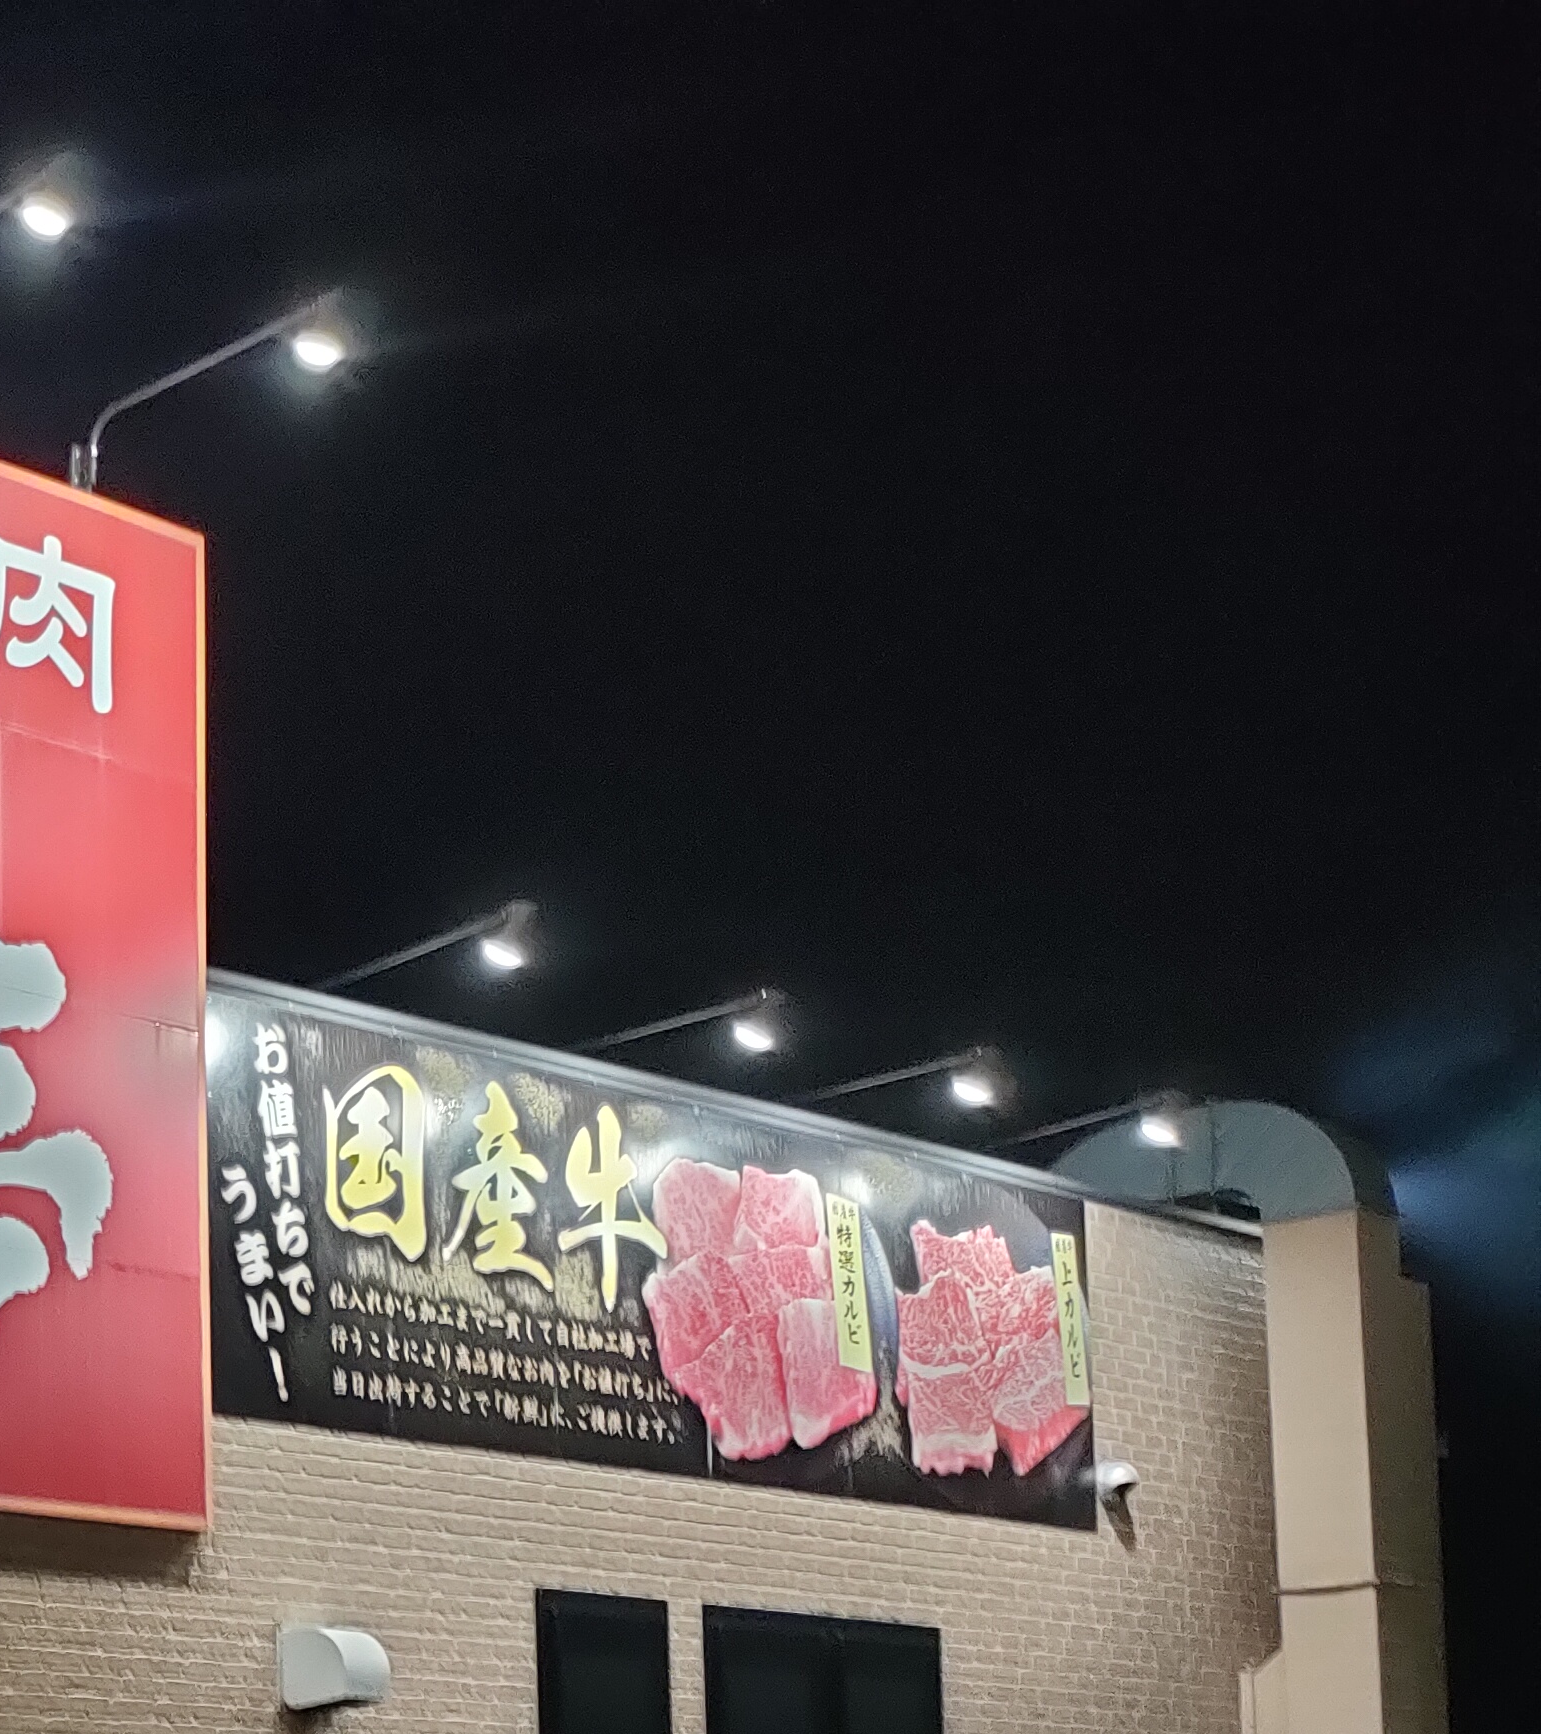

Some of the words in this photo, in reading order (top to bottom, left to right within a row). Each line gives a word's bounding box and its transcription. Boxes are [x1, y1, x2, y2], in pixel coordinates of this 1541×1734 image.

[254, 1022, 315, 1317] お値打ちで
[323, 1065, 668, 1313] 国産牛
[836, 1224, 860, 1346] 特選カルビ
[1061, 1261, 1081, 1379] 上カルビ
